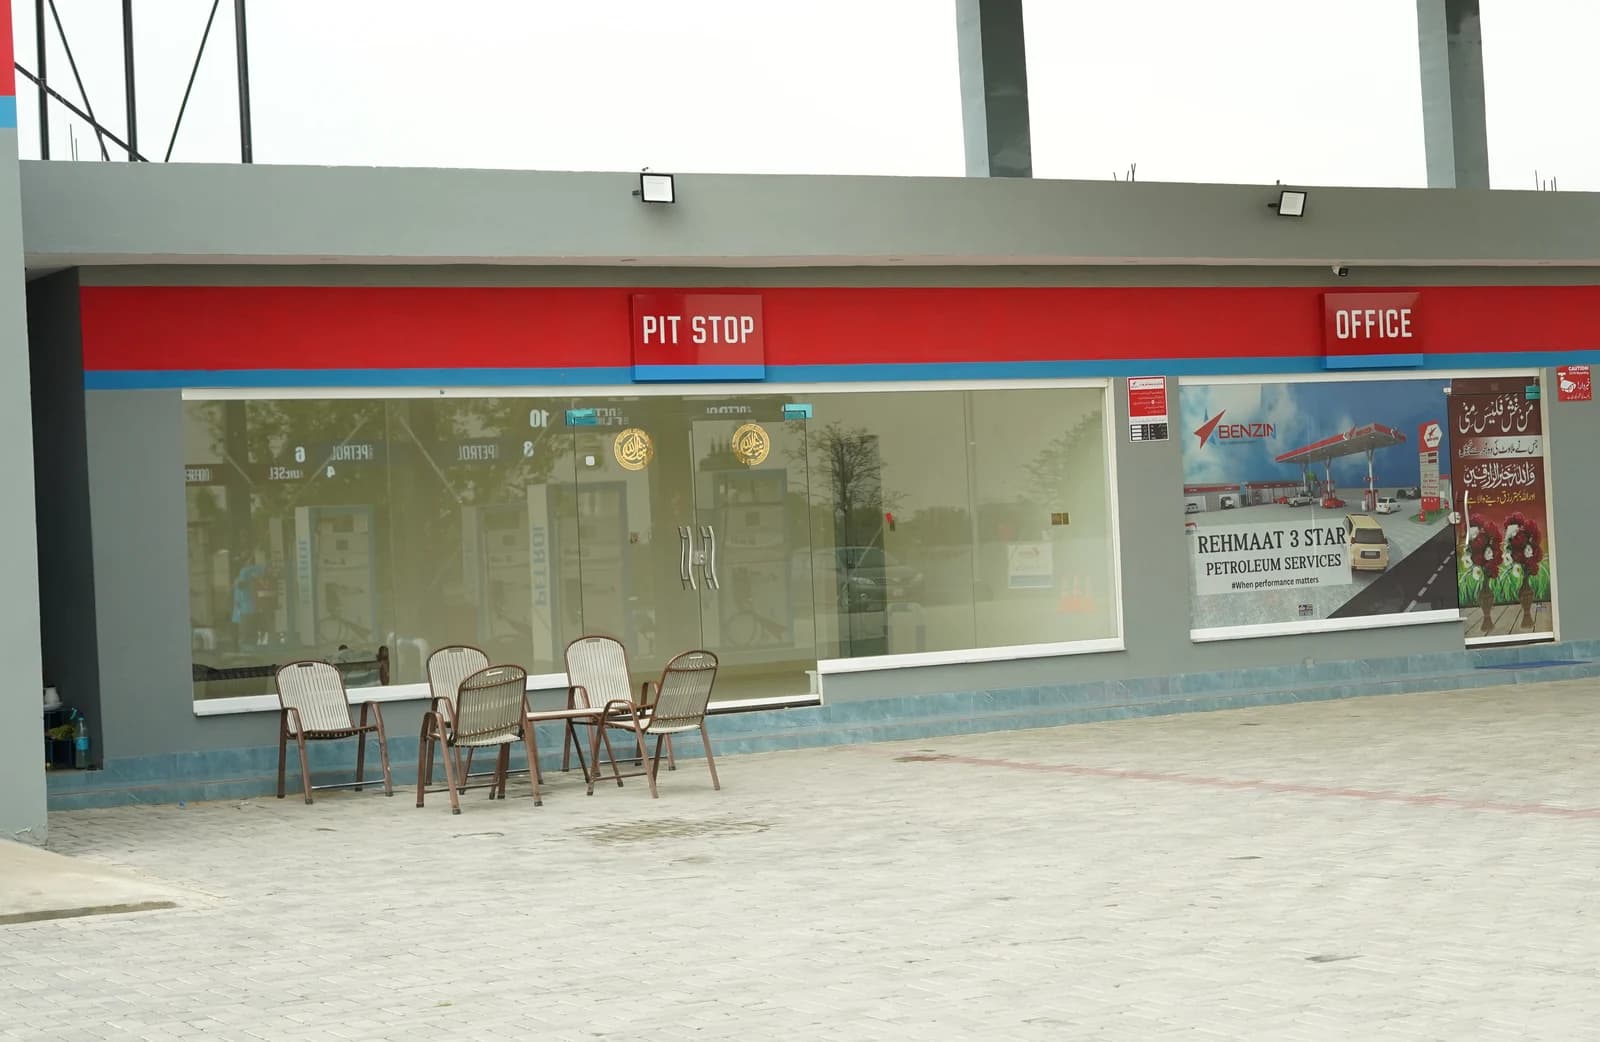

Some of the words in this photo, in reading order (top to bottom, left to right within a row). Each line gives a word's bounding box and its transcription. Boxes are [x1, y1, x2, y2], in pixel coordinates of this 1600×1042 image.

[642, 315, 681, 344] PIT
[691, 315, 755, 344] STOP
[1335, 308, 1413, 339] OFFICE
[1218, 423, 1277, 440] BENZIN
[1198, 531, 1284, 553] REHMAAT
[1289, 530, 1300, 548] 3
[1304, 527, 1347, 547] STAR
[1206, 557, 1281, 576] PETROLEUM
[1284, 553, 1342, 570] SERVICES
[1231, 580, 1253, 589] #When
[1254, 578, 1295, 591] performance
[1295, 577, 1319, 585] matters
